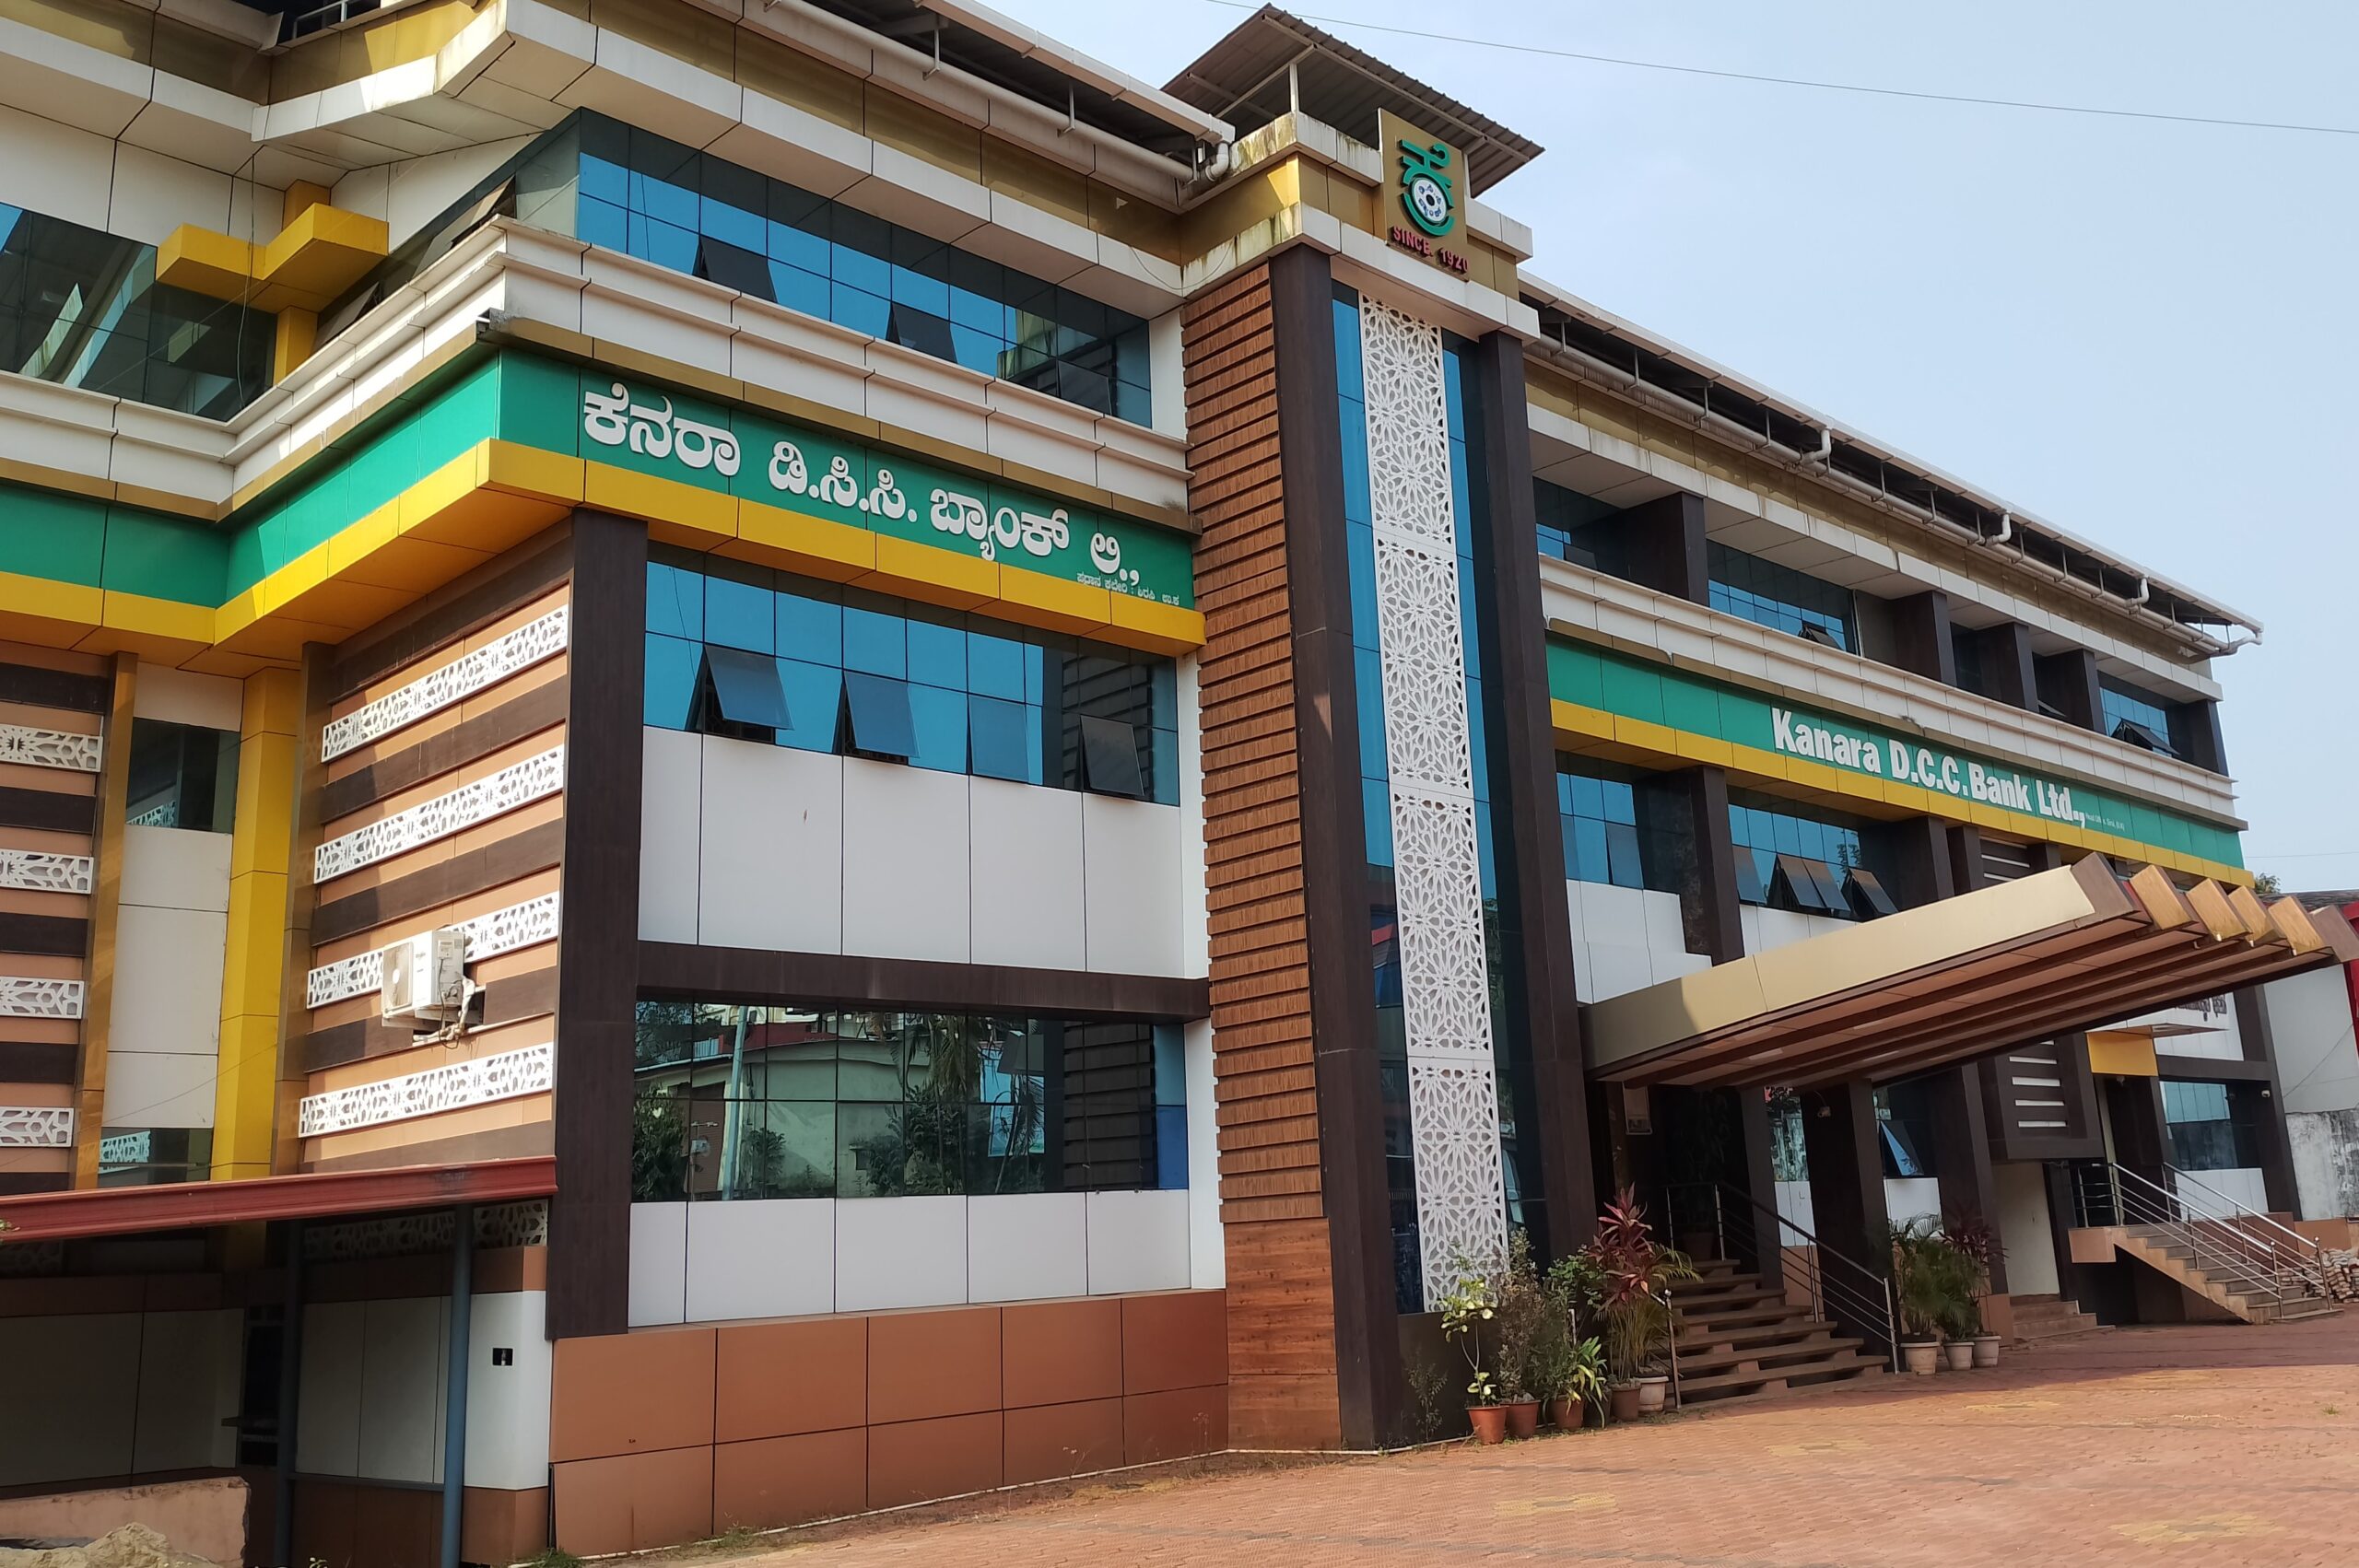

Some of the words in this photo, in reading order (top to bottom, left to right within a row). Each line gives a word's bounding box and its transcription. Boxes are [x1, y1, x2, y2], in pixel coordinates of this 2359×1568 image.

[1393, 226, 1431, 255] SINCE
[1440, 247, 1469, 272] 1920
[583, 382, 741, 476] ಕೆನರಾ
[769, 441, 918, 523] ಡಿ.ಸಿ.ಸಿ.
[930, 488, 1070, 561] ಬ್ಯಾಂಕ್
[1771, 707, 1882, 775] Kanara
